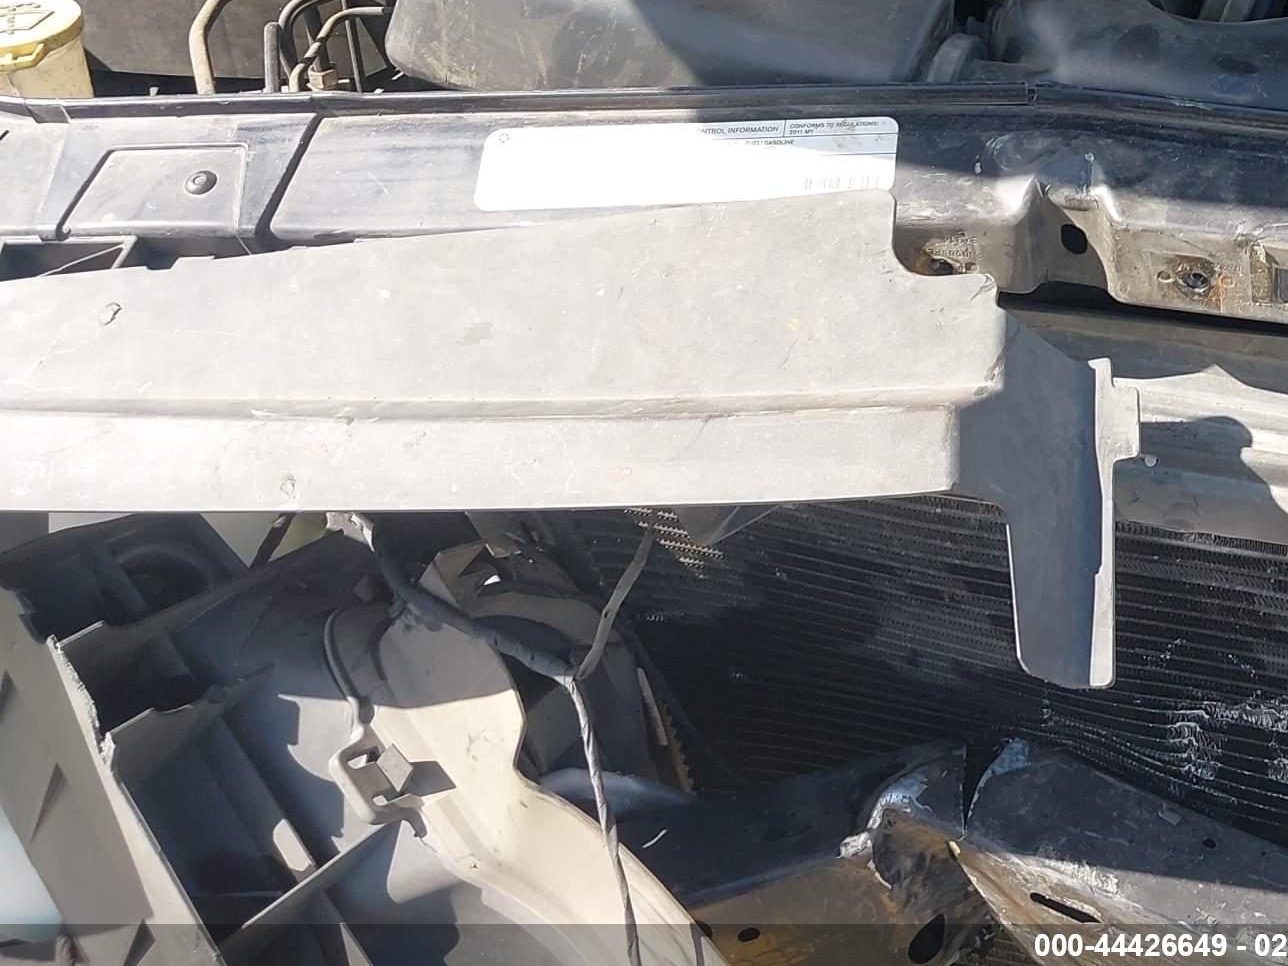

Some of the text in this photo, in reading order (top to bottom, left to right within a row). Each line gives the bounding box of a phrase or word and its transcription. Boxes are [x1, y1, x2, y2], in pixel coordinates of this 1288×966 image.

[696, 125, 780, 135] ONTROL INFORMATION
[789, 122, 825, 130] CONFORMS
